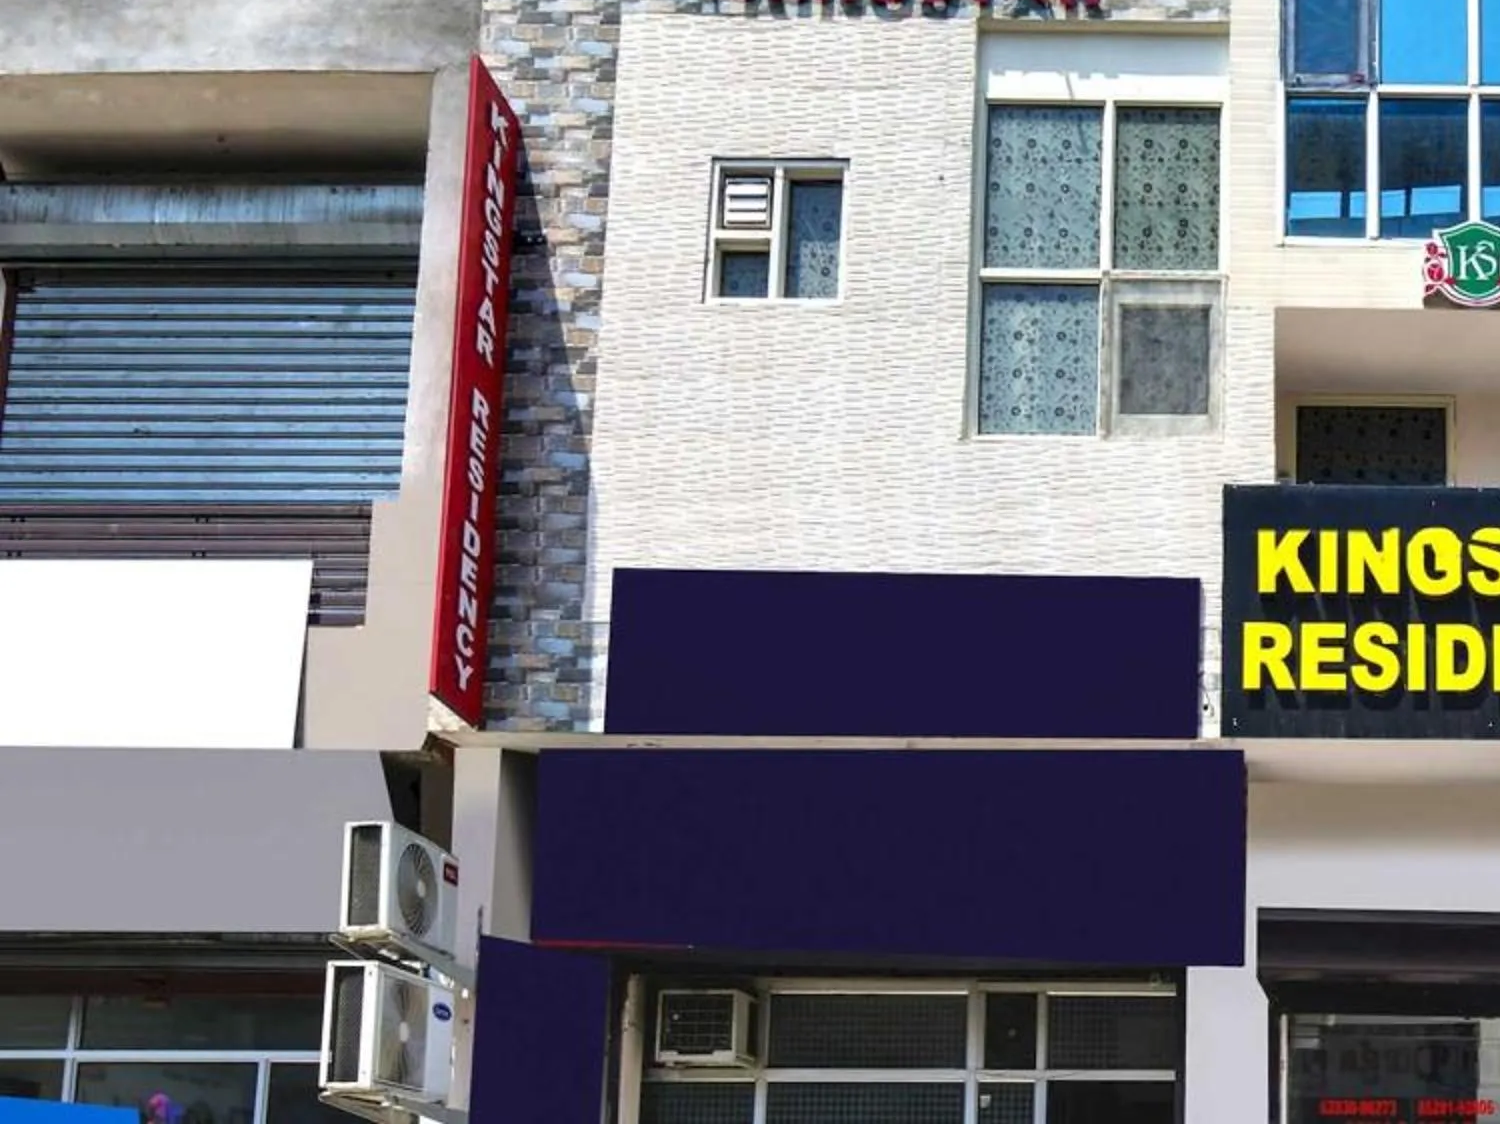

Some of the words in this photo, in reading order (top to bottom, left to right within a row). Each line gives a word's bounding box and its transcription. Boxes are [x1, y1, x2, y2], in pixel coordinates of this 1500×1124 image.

[476, 100, 508, 369] KINGSTAR
[1456, 240, 1498, 281] KS
[455, 387, 491, 692] RESIDENCY
